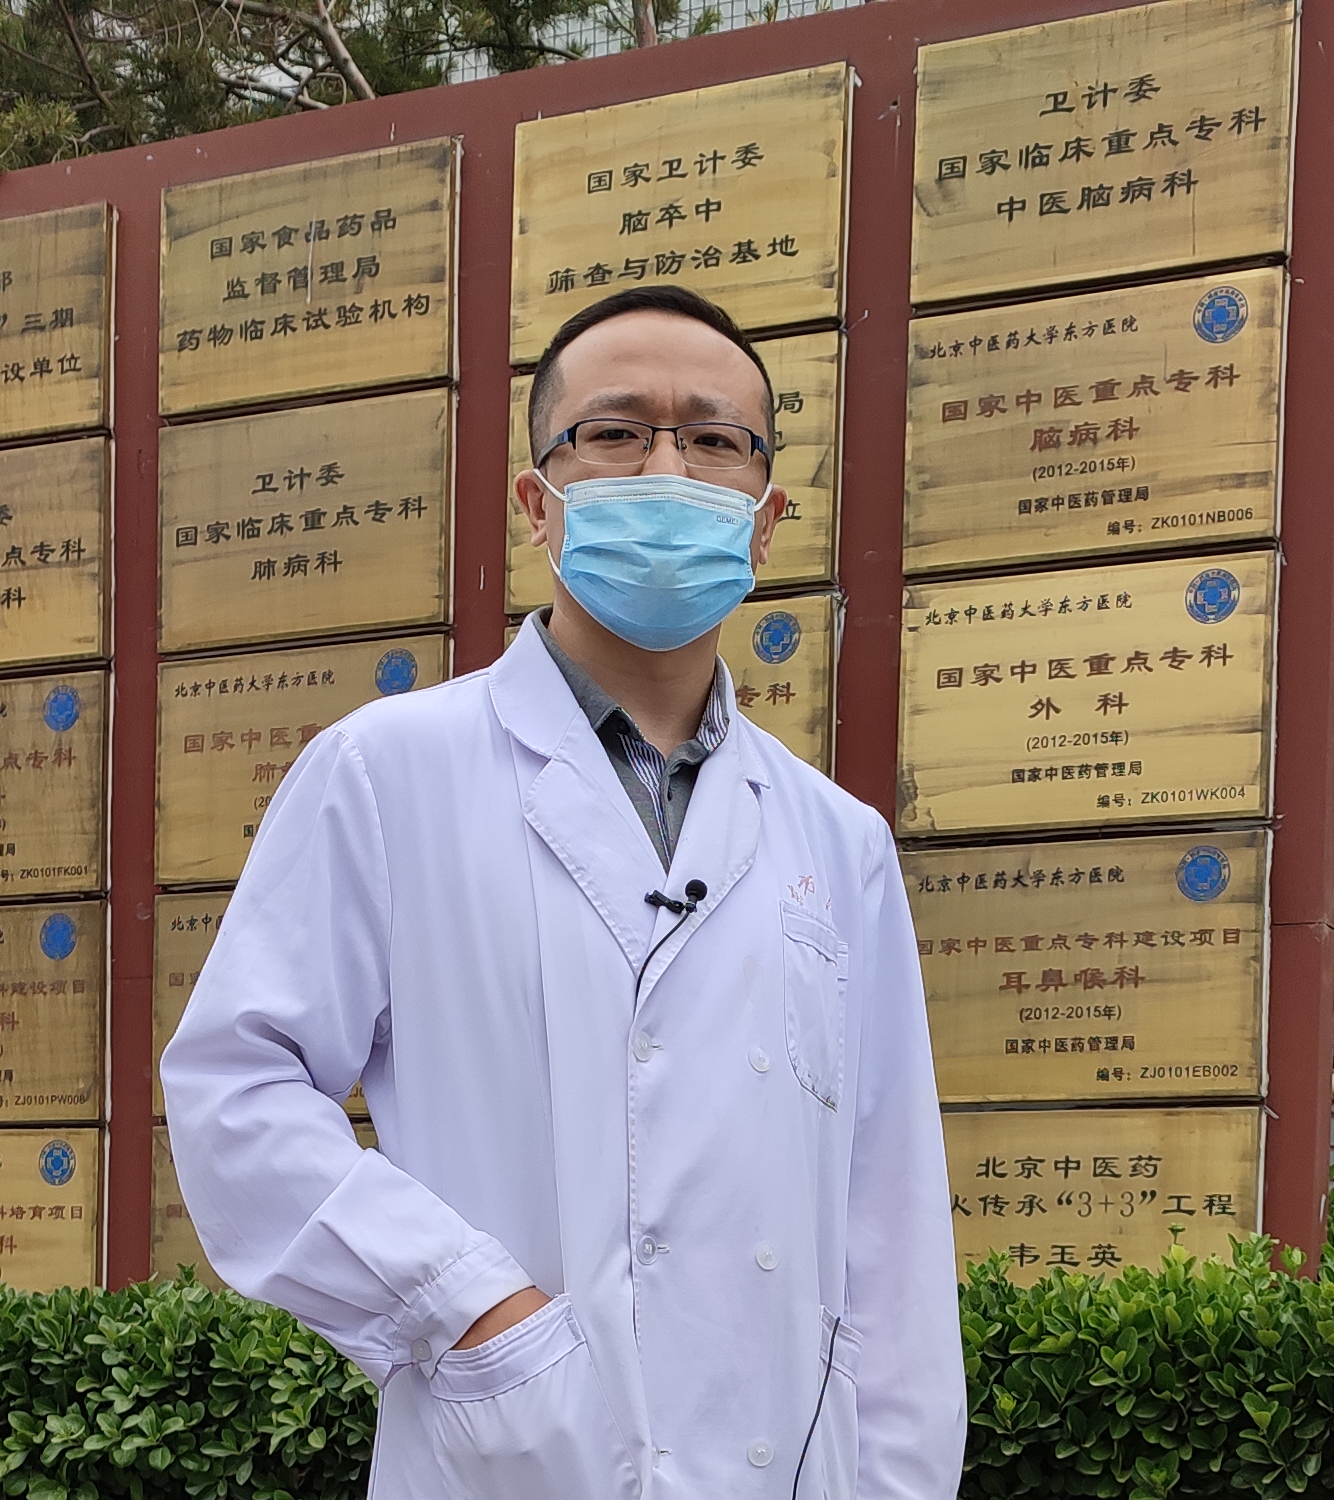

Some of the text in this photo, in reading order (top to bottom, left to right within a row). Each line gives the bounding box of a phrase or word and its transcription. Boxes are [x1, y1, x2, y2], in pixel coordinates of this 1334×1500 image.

[1039, 73, 1162, 118] 卫计委
[937, 105, 1267, 183] 国家临床重点专科
[586, 142, 765, 195] 国家卫计委
[996, 168, 1200, 223] 中医脑病科
[618, 197, 723, 236] 脑卒中
[209, 207, 398, 261] 国家食品药品
[222, 255, 381, 303] 监督管理局
[548, 234, 800, 294] 筛查与防治基地
[176, 292, 431, 353] 药物临床试验机构
[929, 314, 1139, 360] 北京中医药大学东方医院
[774, 391, 804, 415] 局
[941, 362, 1242, 424] 国家中医重点专科
[1029, 416, 1141, 454] 脑病科
[251, 462, 346, 495] 卫计委
[1032, 455, 1136, 483] (2012-2015年)
[1017, 486, 1150, 516] 国家中医药管理局
[175, 495, 429, 549] 国家临床重点专科
[250, 549, 344, 581] 肺病科
[924, 591, 1134, 627] 北京中医药大学东方医院
[936, 642, 1234, 690] 国家中医重点专科
[174, 668, 336, 699] 北京中医药大学东方医院
[1028, 691, 1130, 721] 外科
[1026, 730, 1130, 753] (2012-2015年)
[1011, 761, 1143, 784] 国家中医药管理局
[918, 865, 1126, 894] 北京中医药大学东方医院
[917, 927, 1242, 958] 国家中医重点专科建设项目
[998, 964, 1146, 994] 耳鼻喉科
[1019, 1004, 1122, 1024] (2012-2015年)
[1004, 1036, 1136, 1056] 国家中医药管理局
[975, 1154, 1163, 1180] 北京中医药
[1007, 1242, 1123, 1269] 韦玉英
